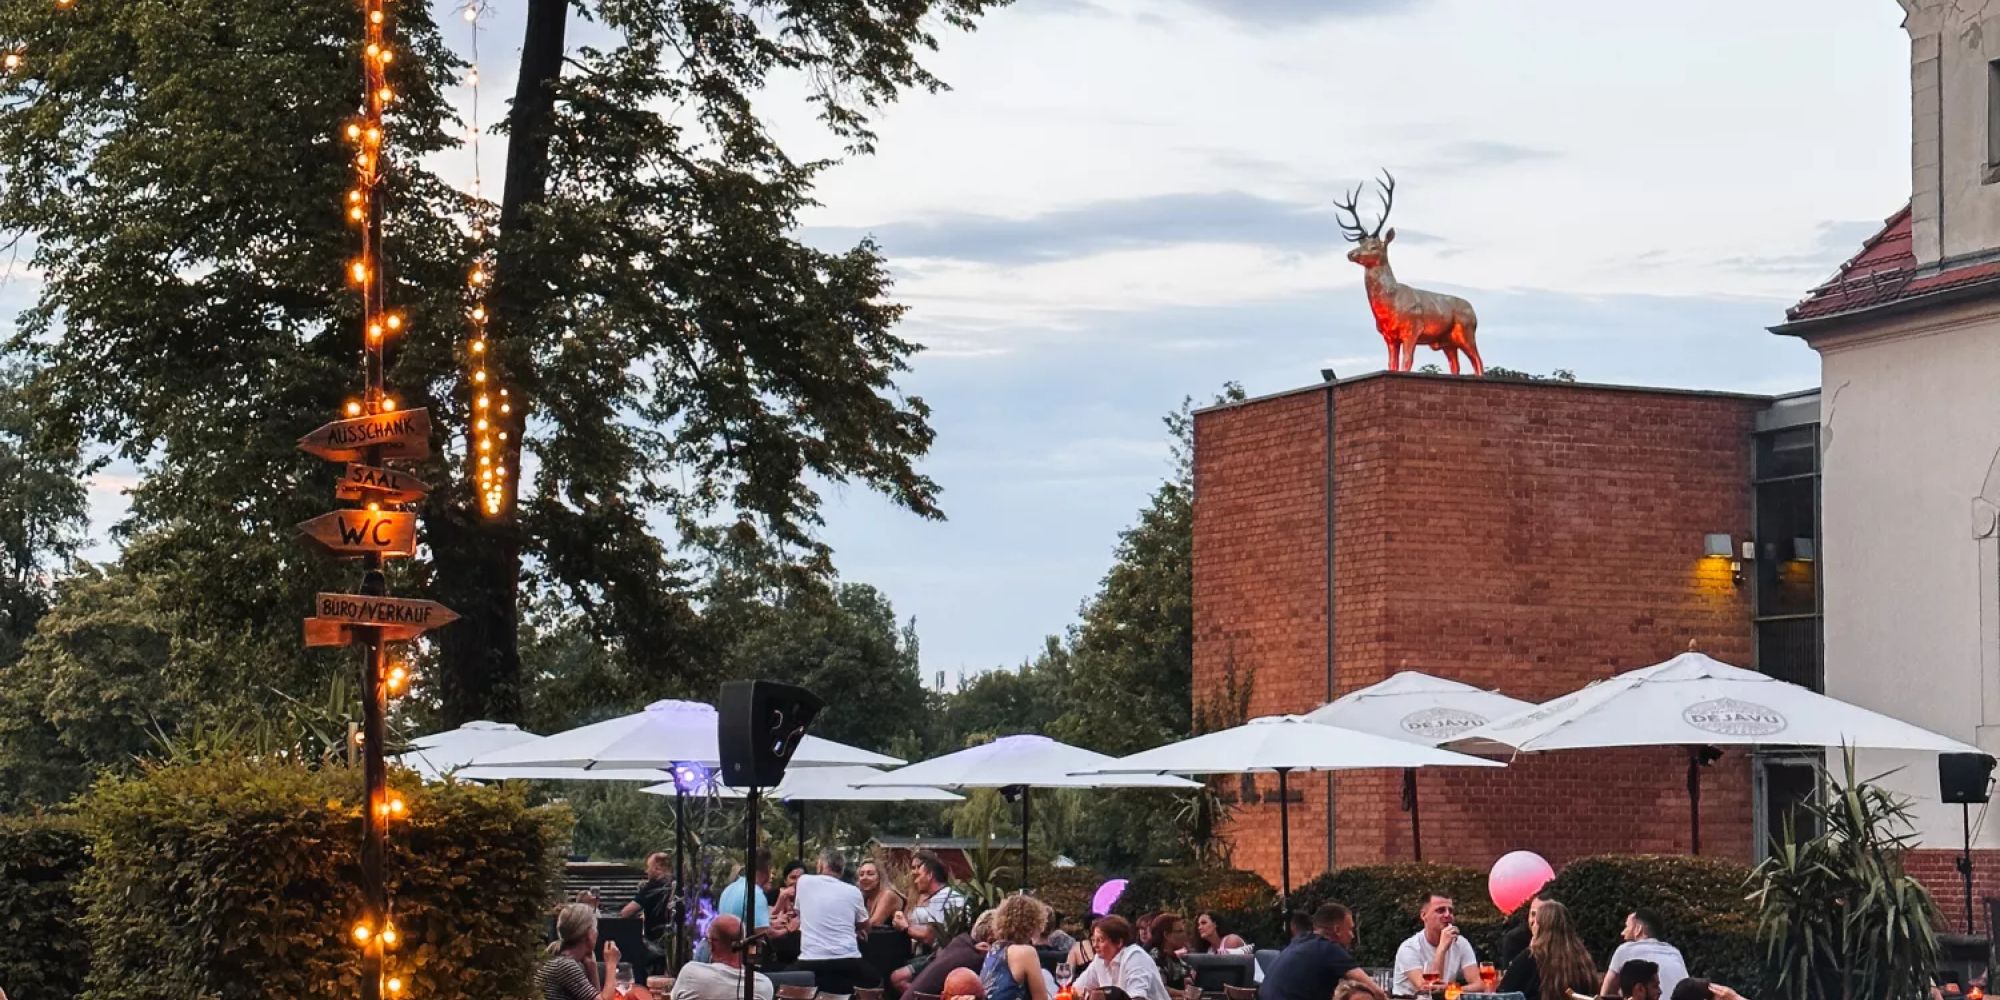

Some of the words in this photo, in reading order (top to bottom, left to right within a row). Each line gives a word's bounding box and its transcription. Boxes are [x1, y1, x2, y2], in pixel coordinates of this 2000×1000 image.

[327, 418, 415, 444] AUSSCHANK
[351, 466, 401, 490] SAAL
[338, 517, 392, 546] WC
